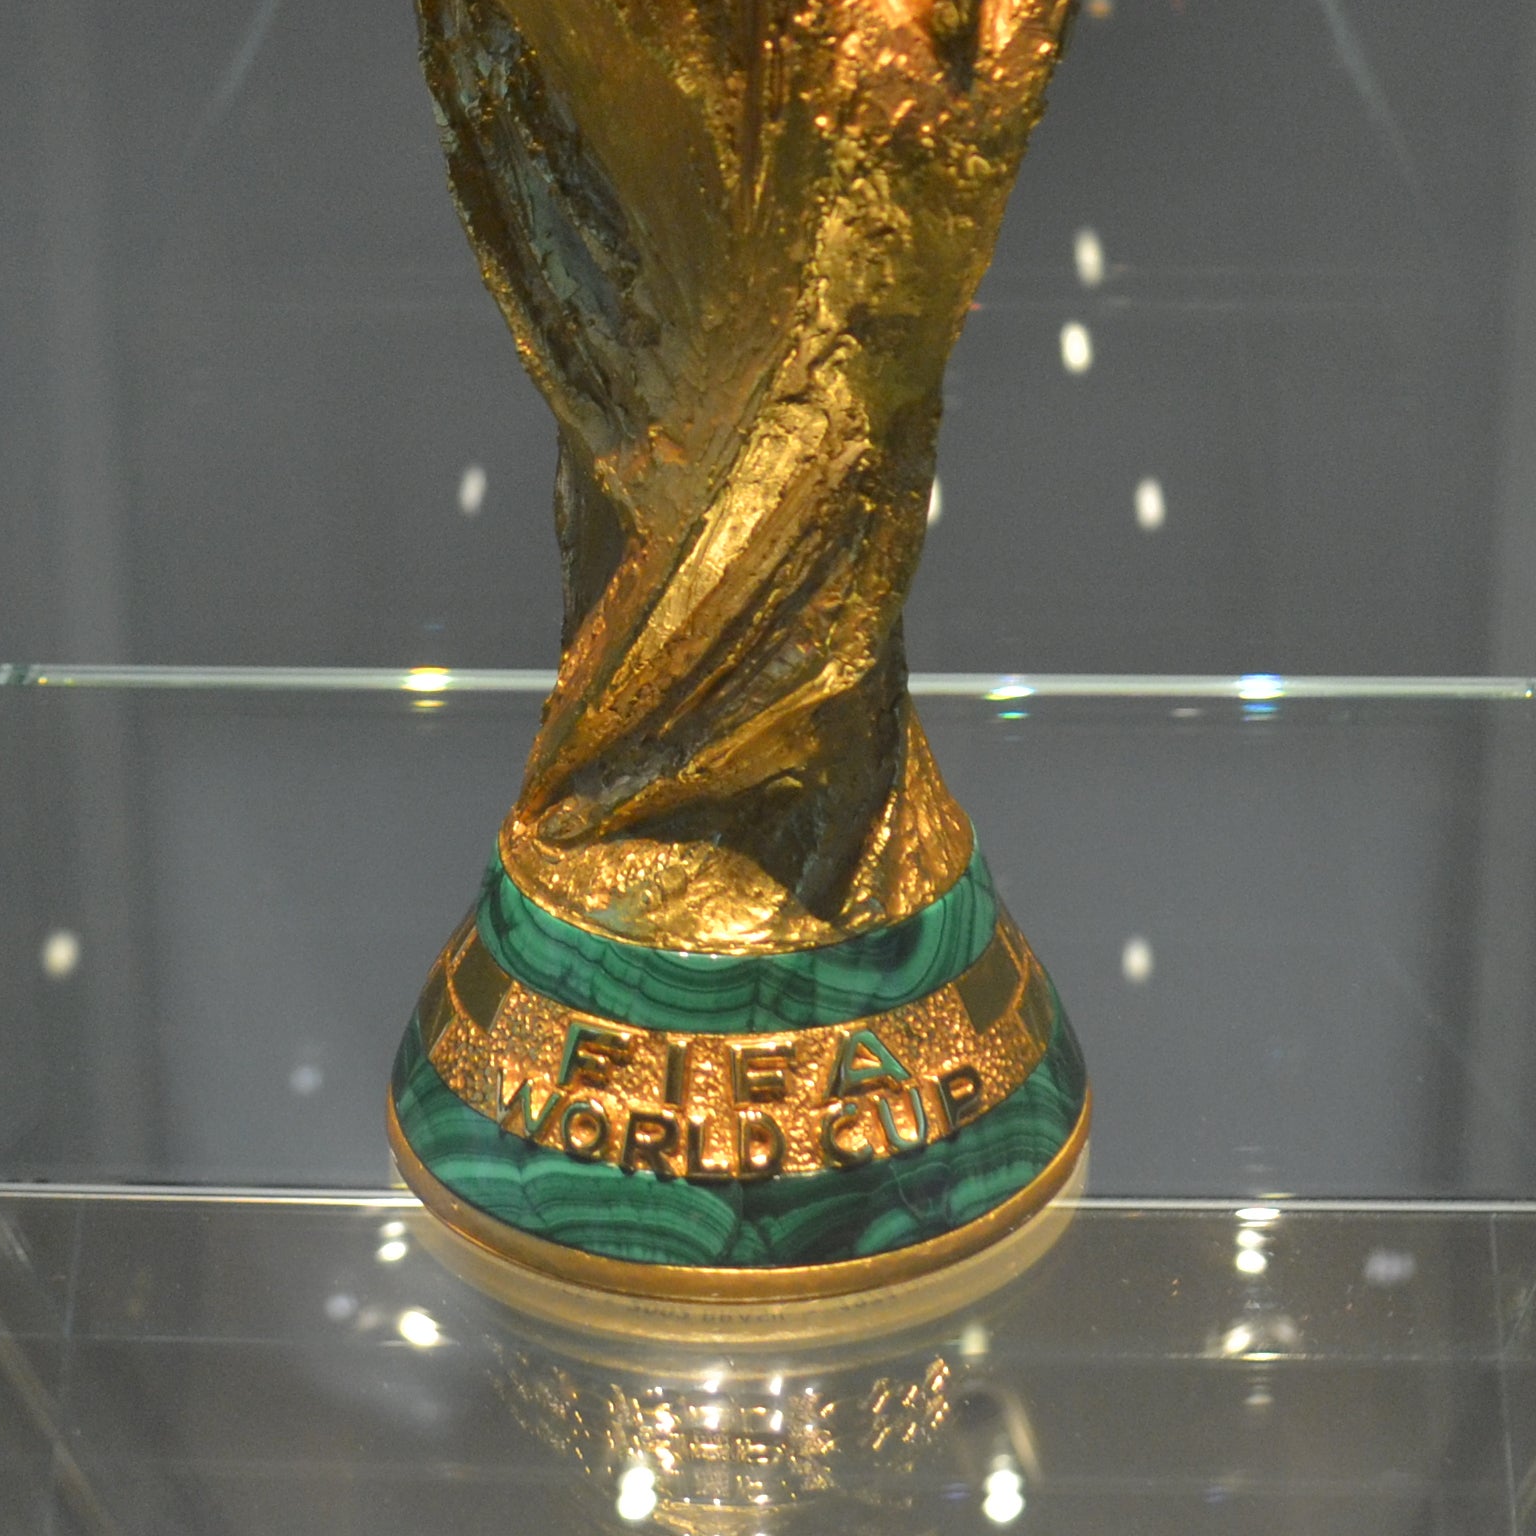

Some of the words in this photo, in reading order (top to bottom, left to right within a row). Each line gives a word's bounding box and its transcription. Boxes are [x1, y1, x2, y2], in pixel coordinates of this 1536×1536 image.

[556, 1020, 914, 1109] FIFA
[495, 1064, 791, 1181] WORLD
[820, 1062, 986, 1166] CUP
